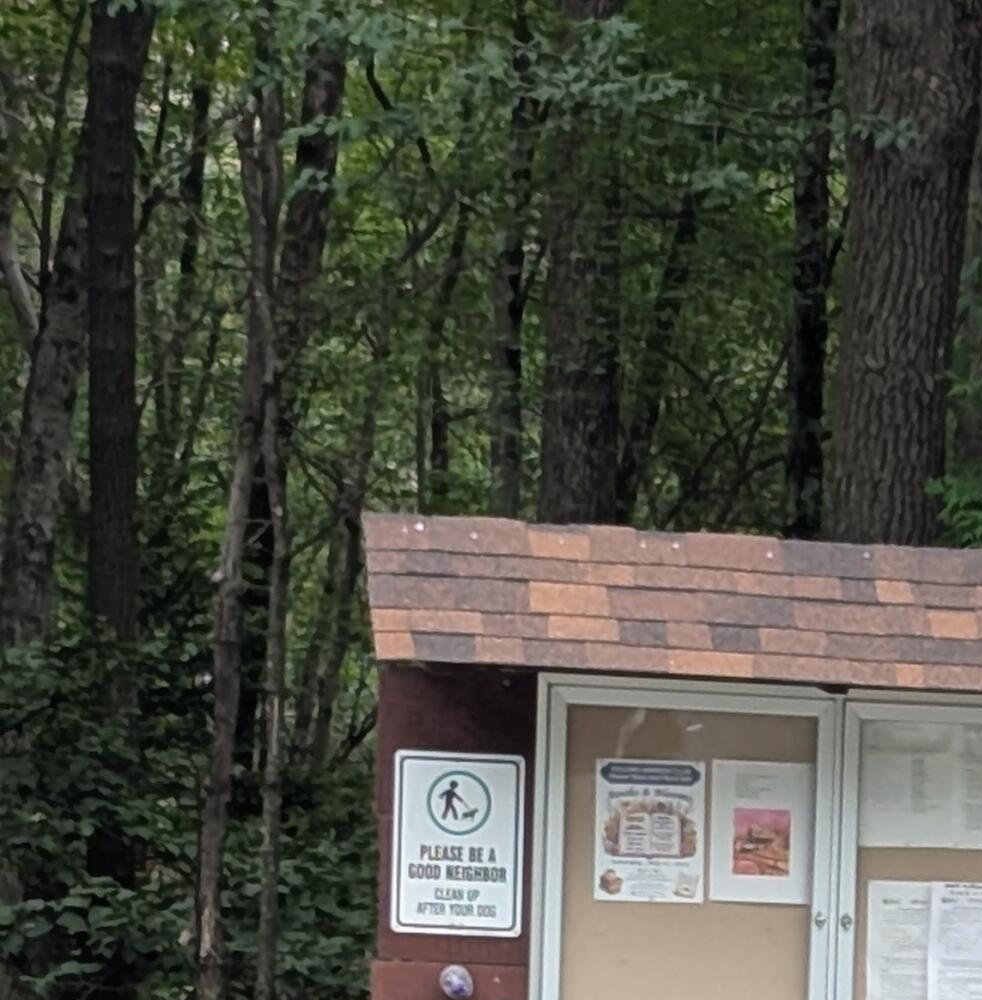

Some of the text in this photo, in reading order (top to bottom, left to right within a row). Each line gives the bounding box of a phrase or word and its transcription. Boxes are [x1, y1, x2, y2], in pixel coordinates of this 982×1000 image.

[420, 844, 496, 863] PLEASE BE A
[408, 862, 507, 883] GOOD NEIGHBOR
[434, 887, 480, 902] CLEAN UP
[417, 902, 496, 918] AFTER YOUR DOG
